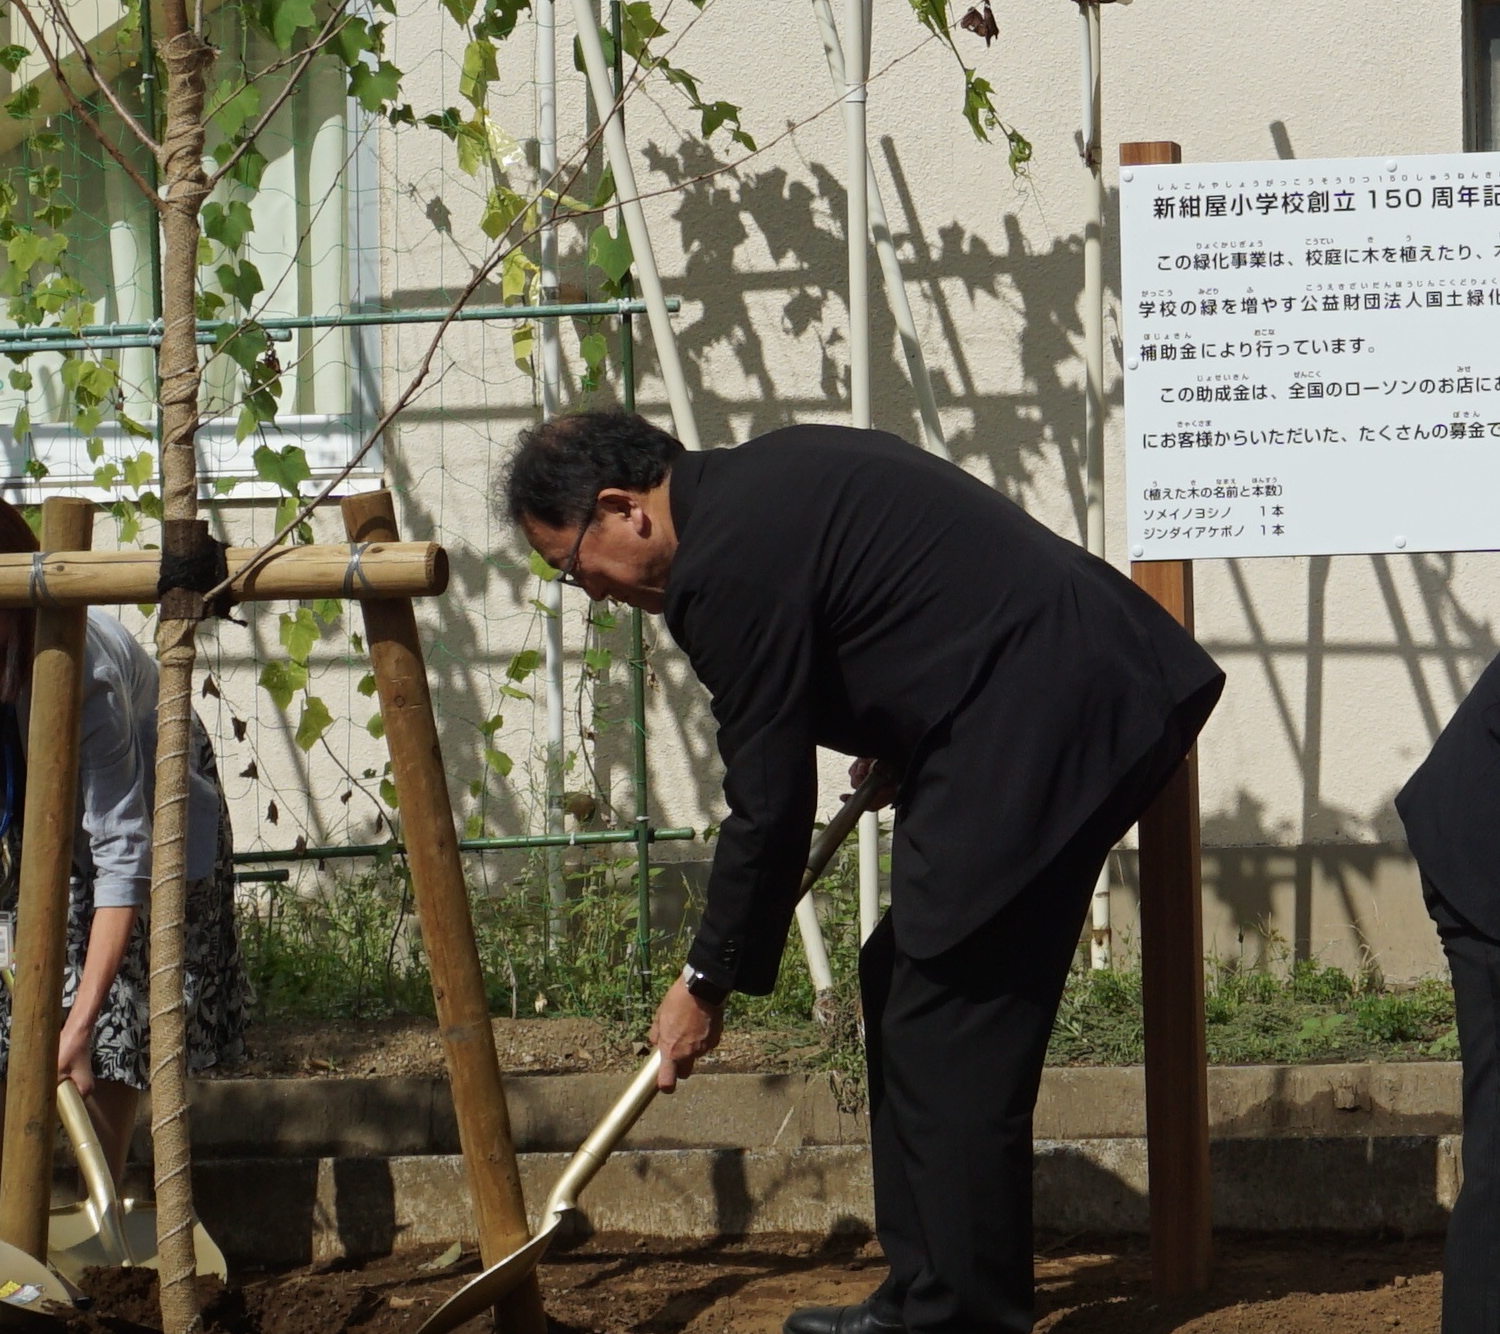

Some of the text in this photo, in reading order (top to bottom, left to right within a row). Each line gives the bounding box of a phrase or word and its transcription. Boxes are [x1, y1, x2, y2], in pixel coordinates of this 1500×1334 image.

[1139, 336, 1375, 363] 補助金により行っています。
[1143, 506, 1232, 522] ソメイノヨシノ
[1143, 524, 1245, 541] ジンダイアケボノ
